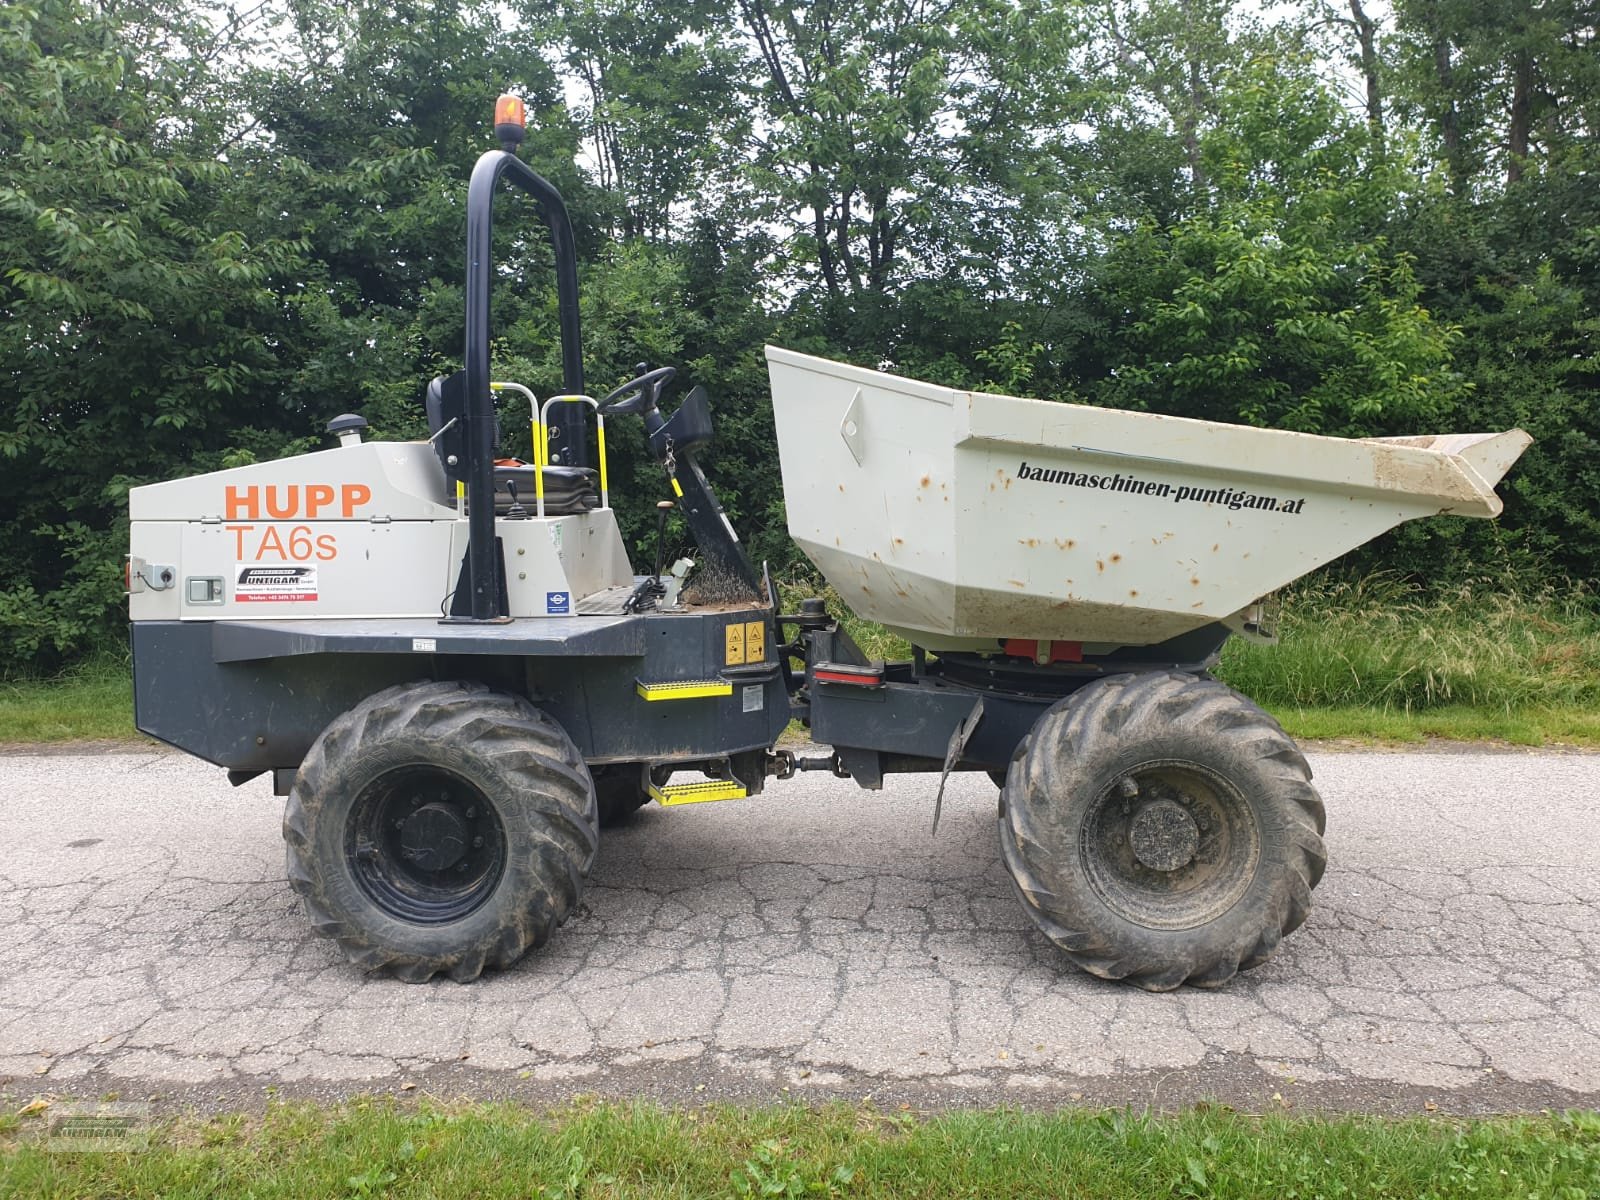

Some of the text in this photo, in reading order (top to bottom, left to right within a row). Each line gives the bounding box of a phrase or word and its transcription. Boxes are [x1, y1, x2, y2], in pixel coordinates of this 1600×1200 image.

[224, 484, 372, 520] HUPP
[1016, 461, 1306, 515] baumaschinen-puntigam.at
[225, 525, 338, 561] TA6s
